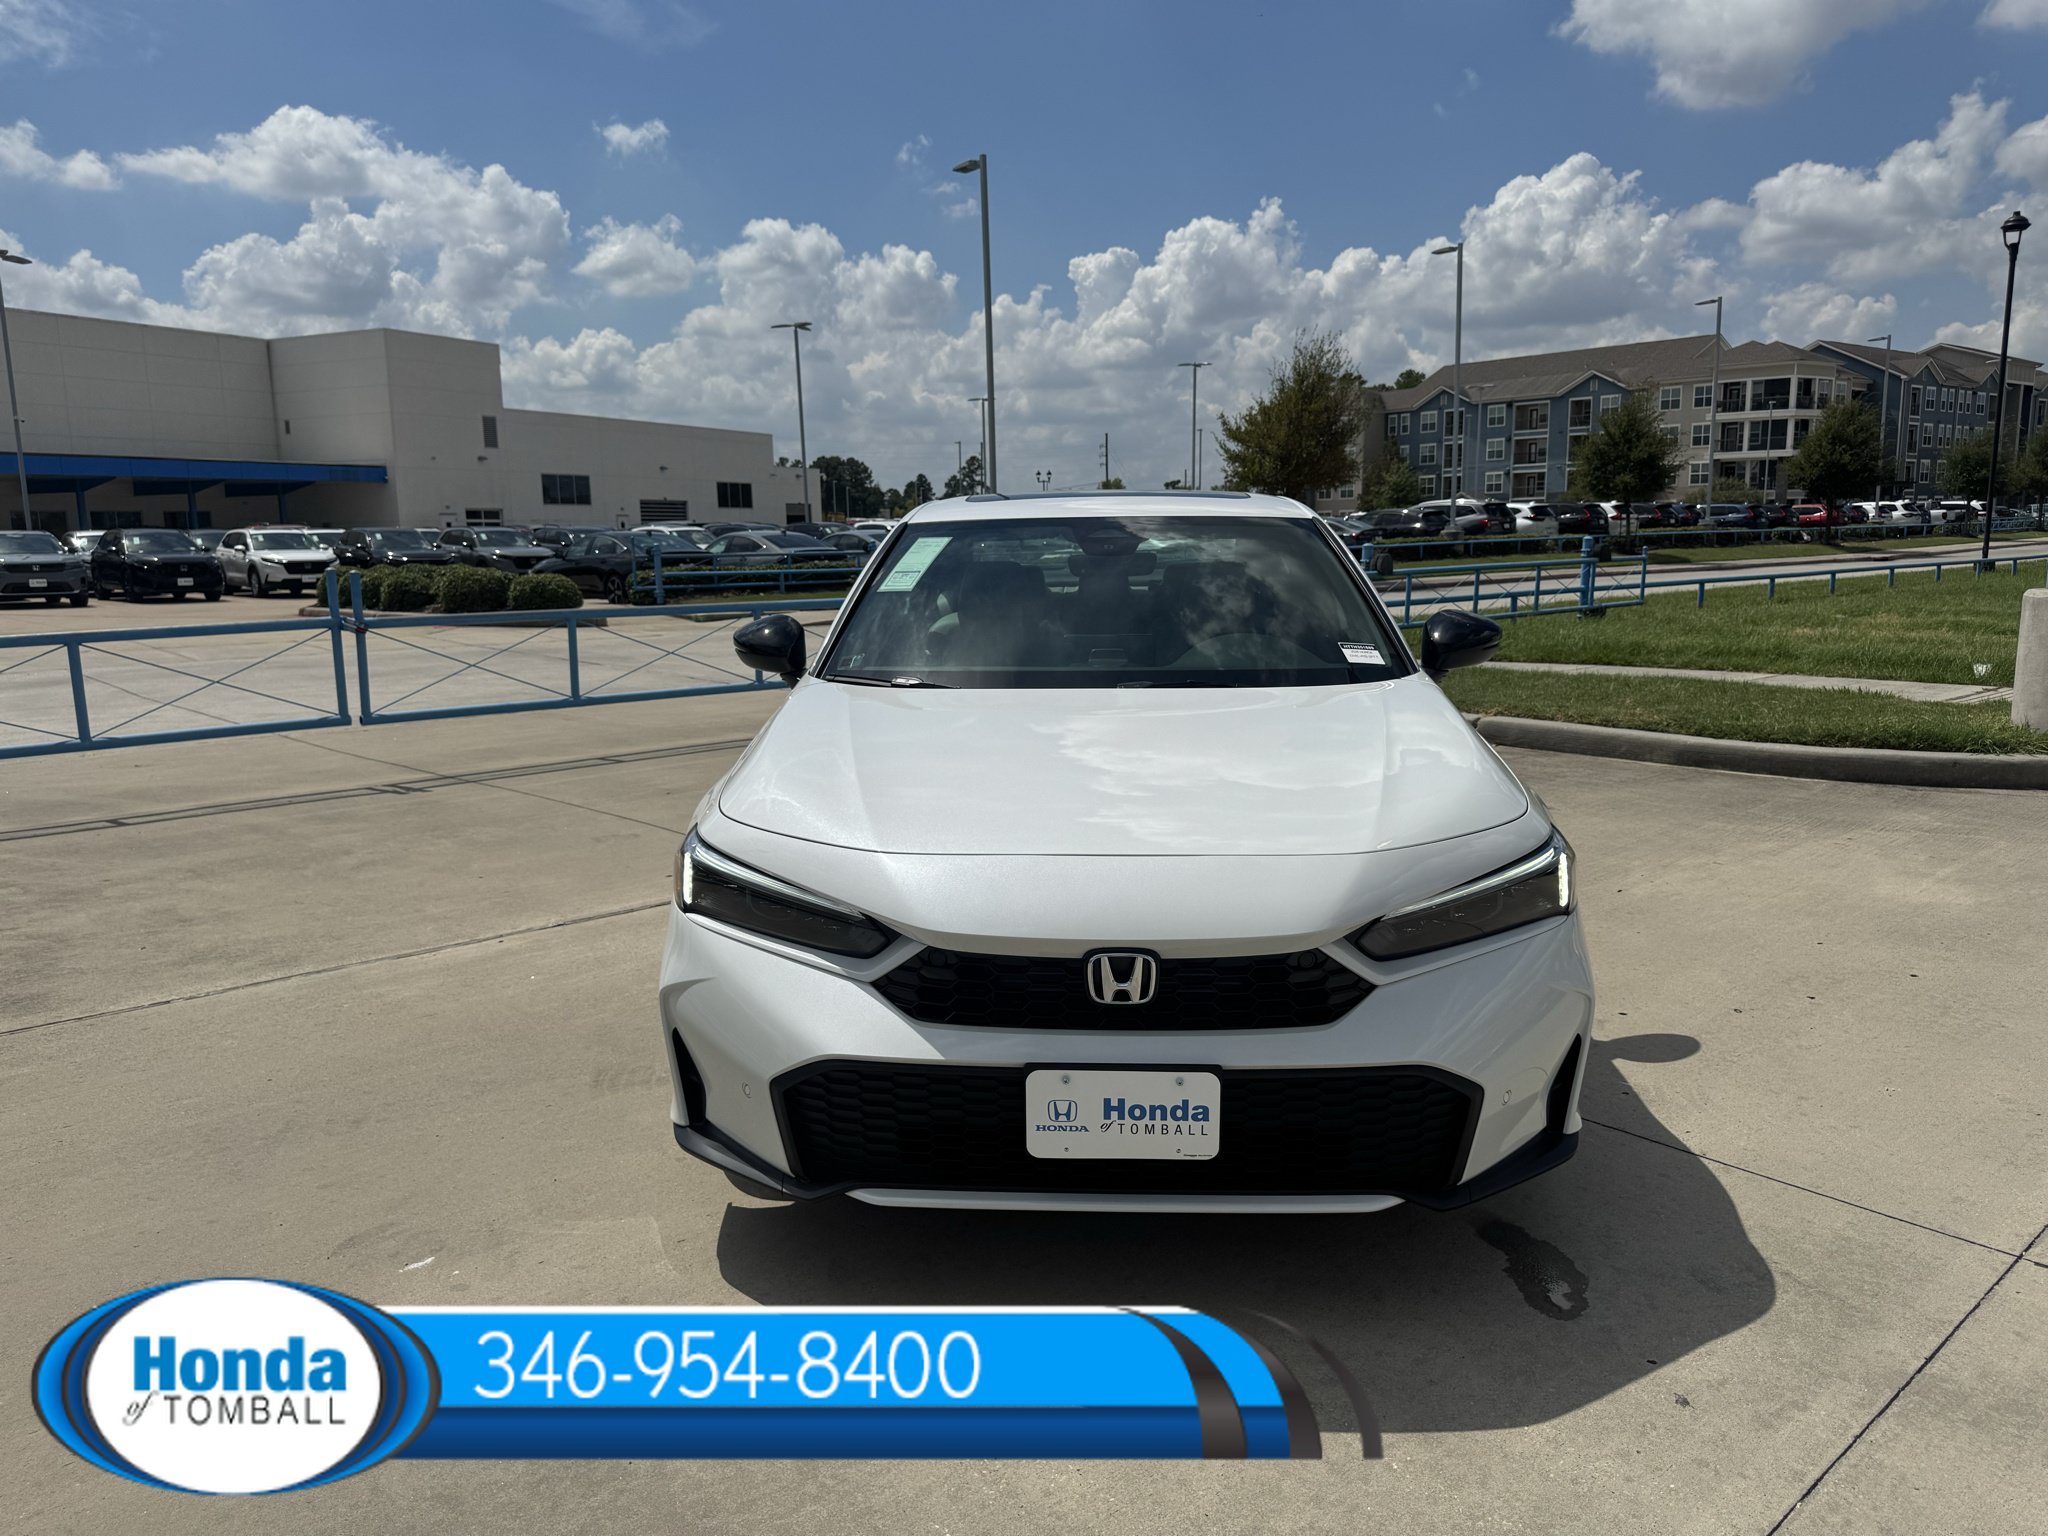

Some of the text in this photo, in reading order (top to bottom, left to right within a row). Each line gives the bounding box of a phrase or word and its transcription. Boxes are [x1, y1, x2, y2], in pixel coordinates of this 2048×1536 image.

[1102, 1097, 1210, 1122] Honda
[1034, 1124, 1090, 1133] HONDA
[1100, 1120, 1209, 1136] of TOMBALL
